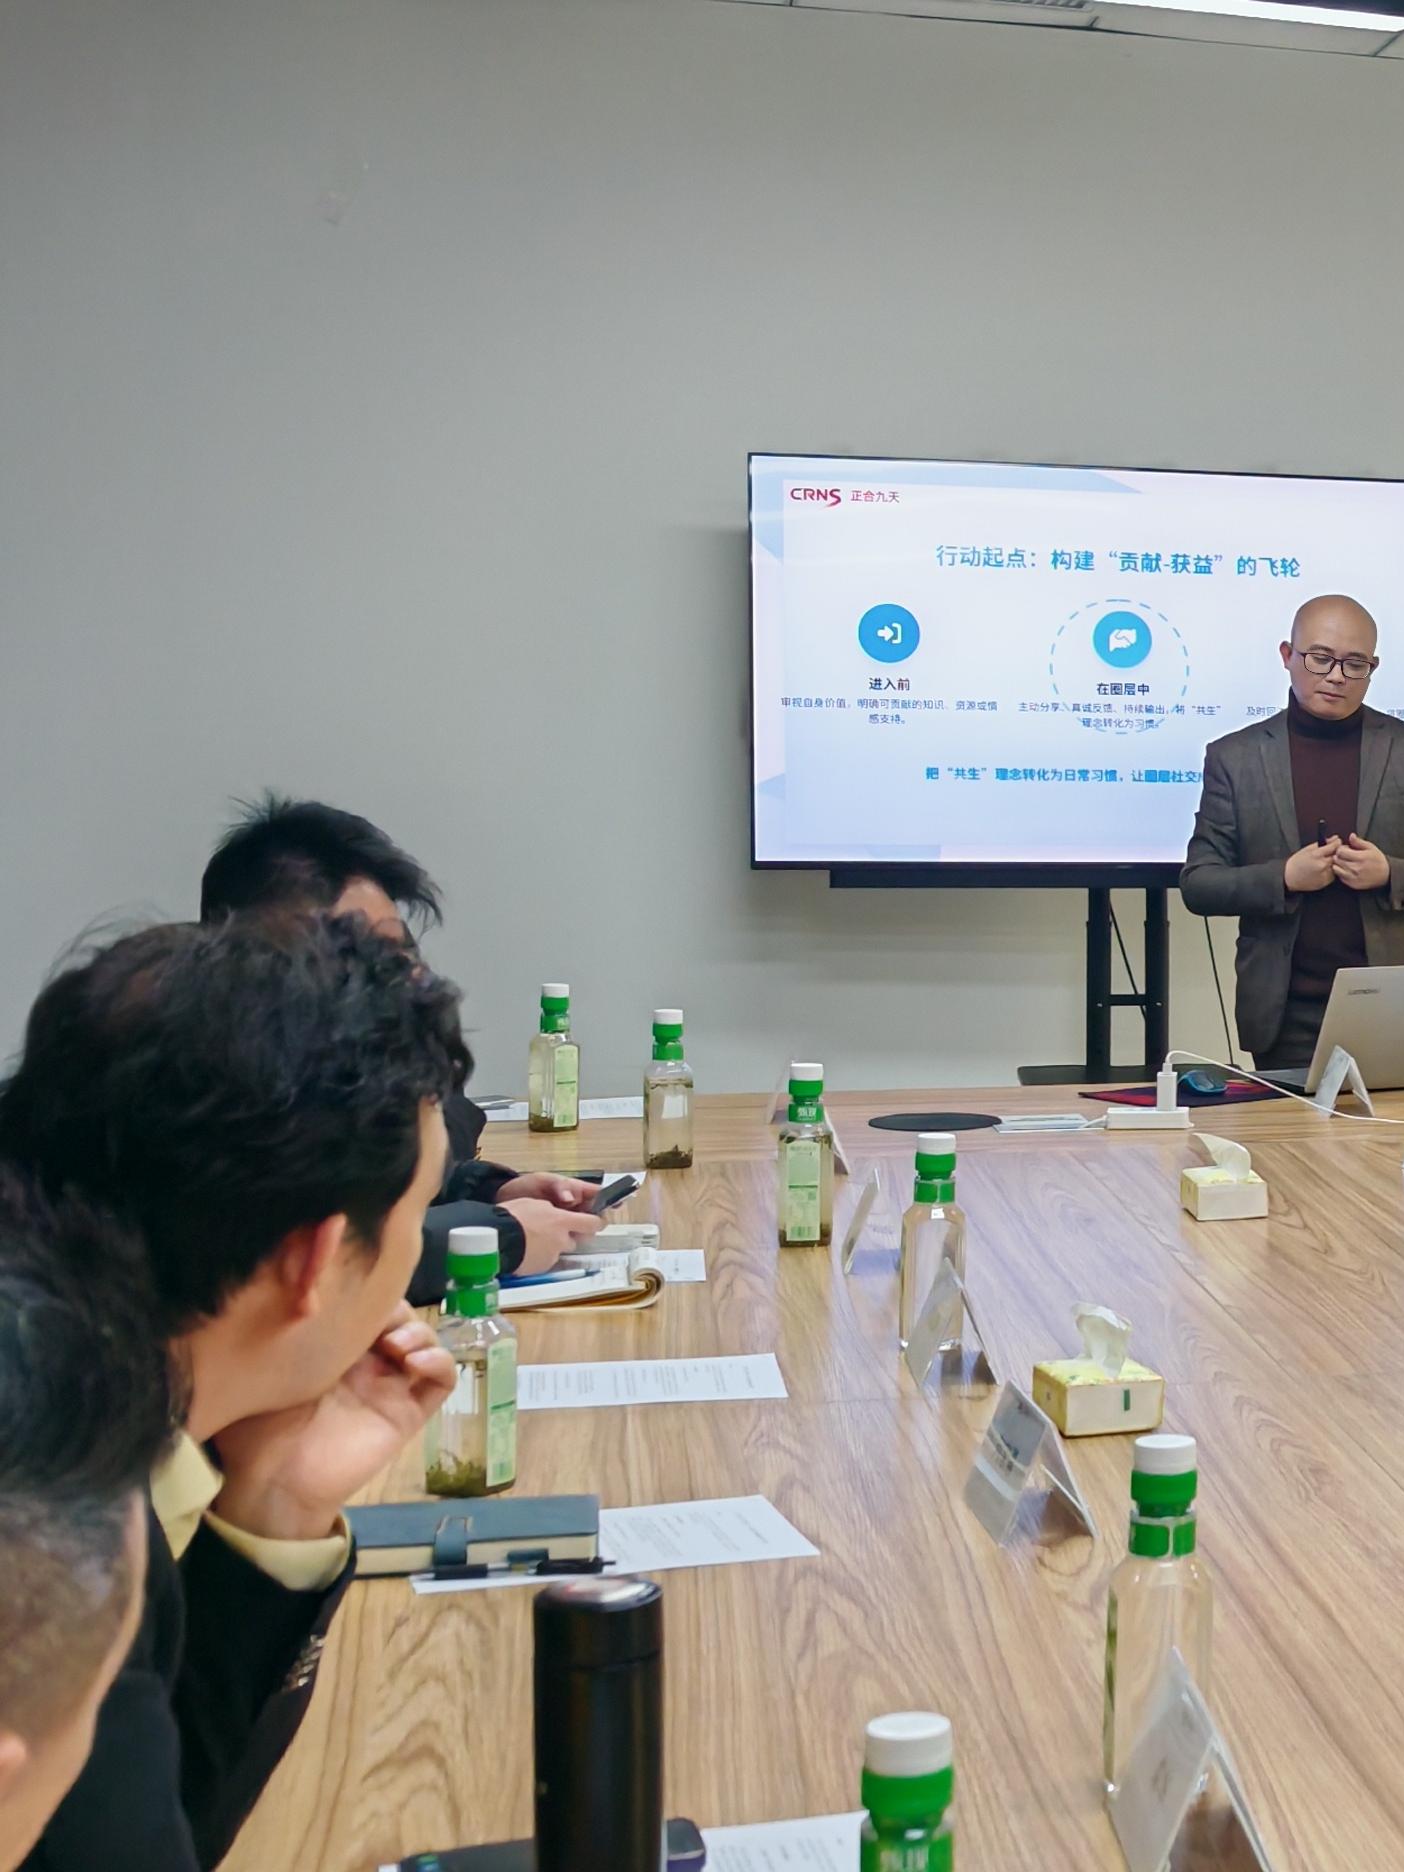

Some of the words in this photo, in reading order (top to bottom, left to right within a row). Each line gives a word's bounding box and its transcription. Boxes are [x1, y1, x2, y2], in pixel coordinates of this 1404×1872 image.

[790, 487, 841, 508] CRNS
[850, 490, 900, 503] 正合九天
[868, 677, 911, 691] 进入前
[1097, 683, 1150, 696] 在圈层中
